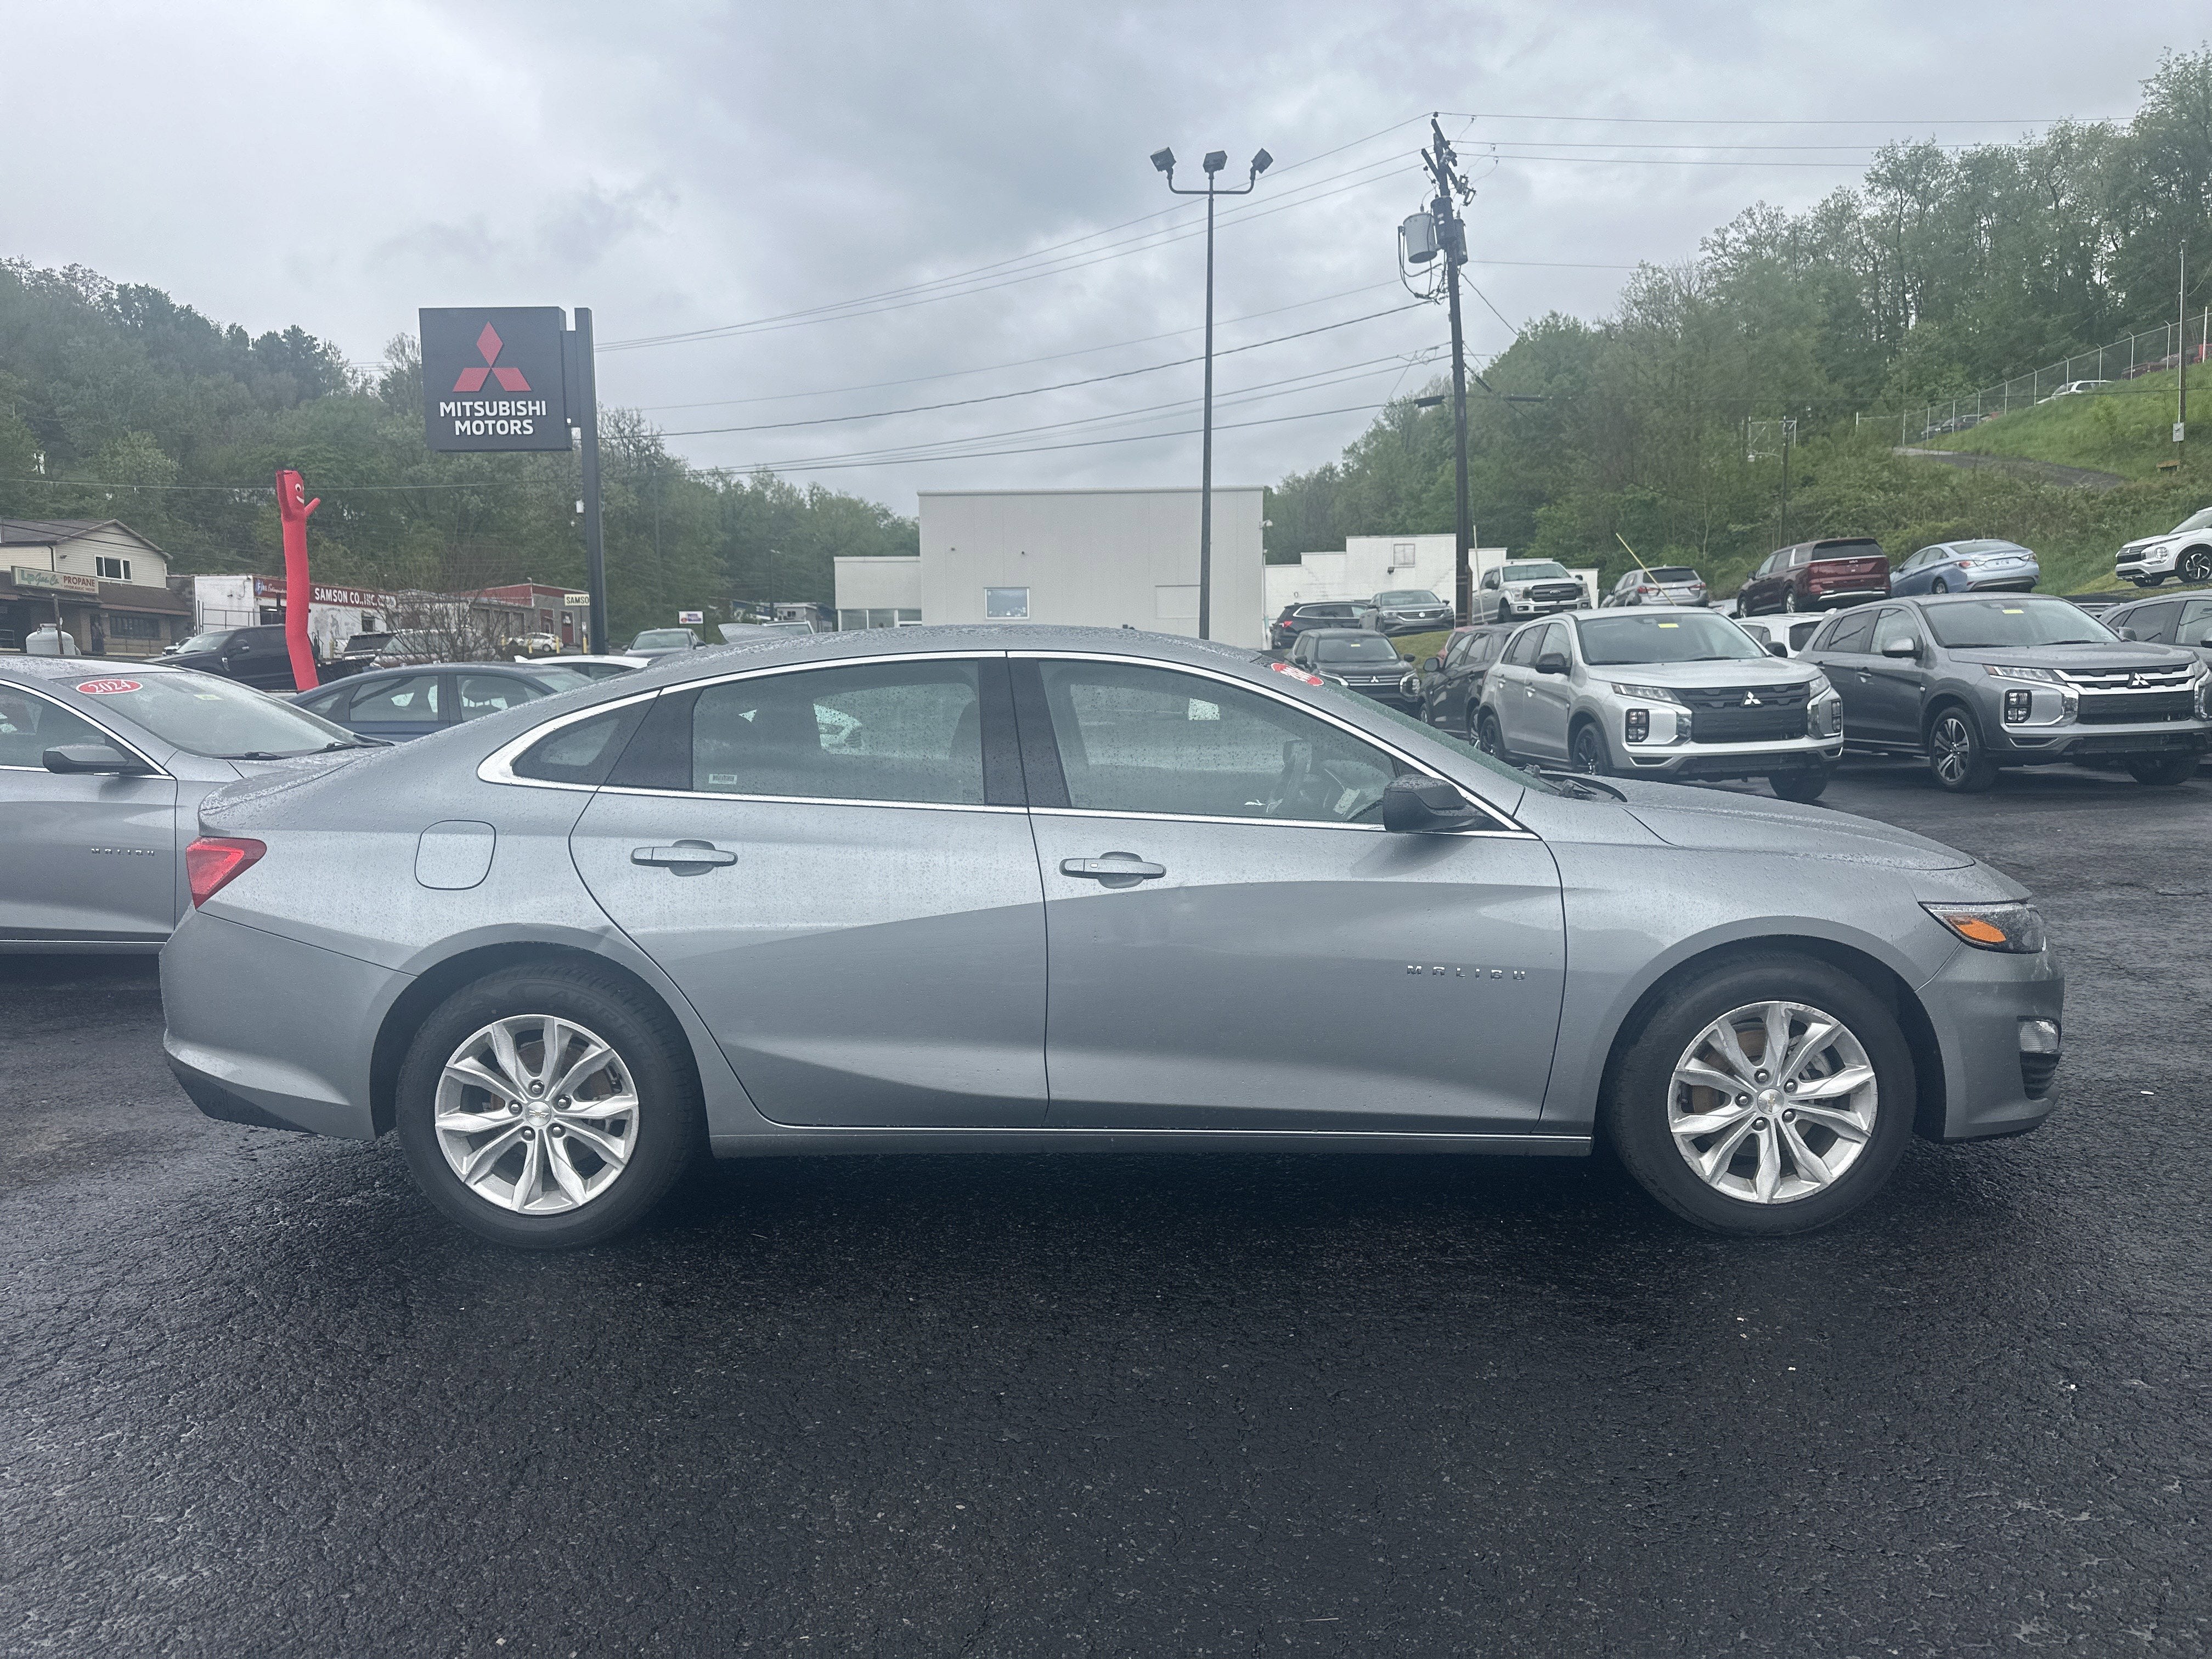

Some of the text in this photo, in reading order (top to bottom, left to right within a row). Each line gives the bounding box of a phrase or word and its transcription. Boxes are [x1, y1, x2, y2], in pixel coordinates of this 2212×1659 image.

[439, 400, 546, 417] MITSUBISHI
[455, 419, 534, 436] MOTORS
[63, 575, 95, 587] PROPANE
[314, 587, 348, 603] SAMSON
[88, 680, 131, 693] 2024
[1407, 965, 1526, 980] MALIBU
